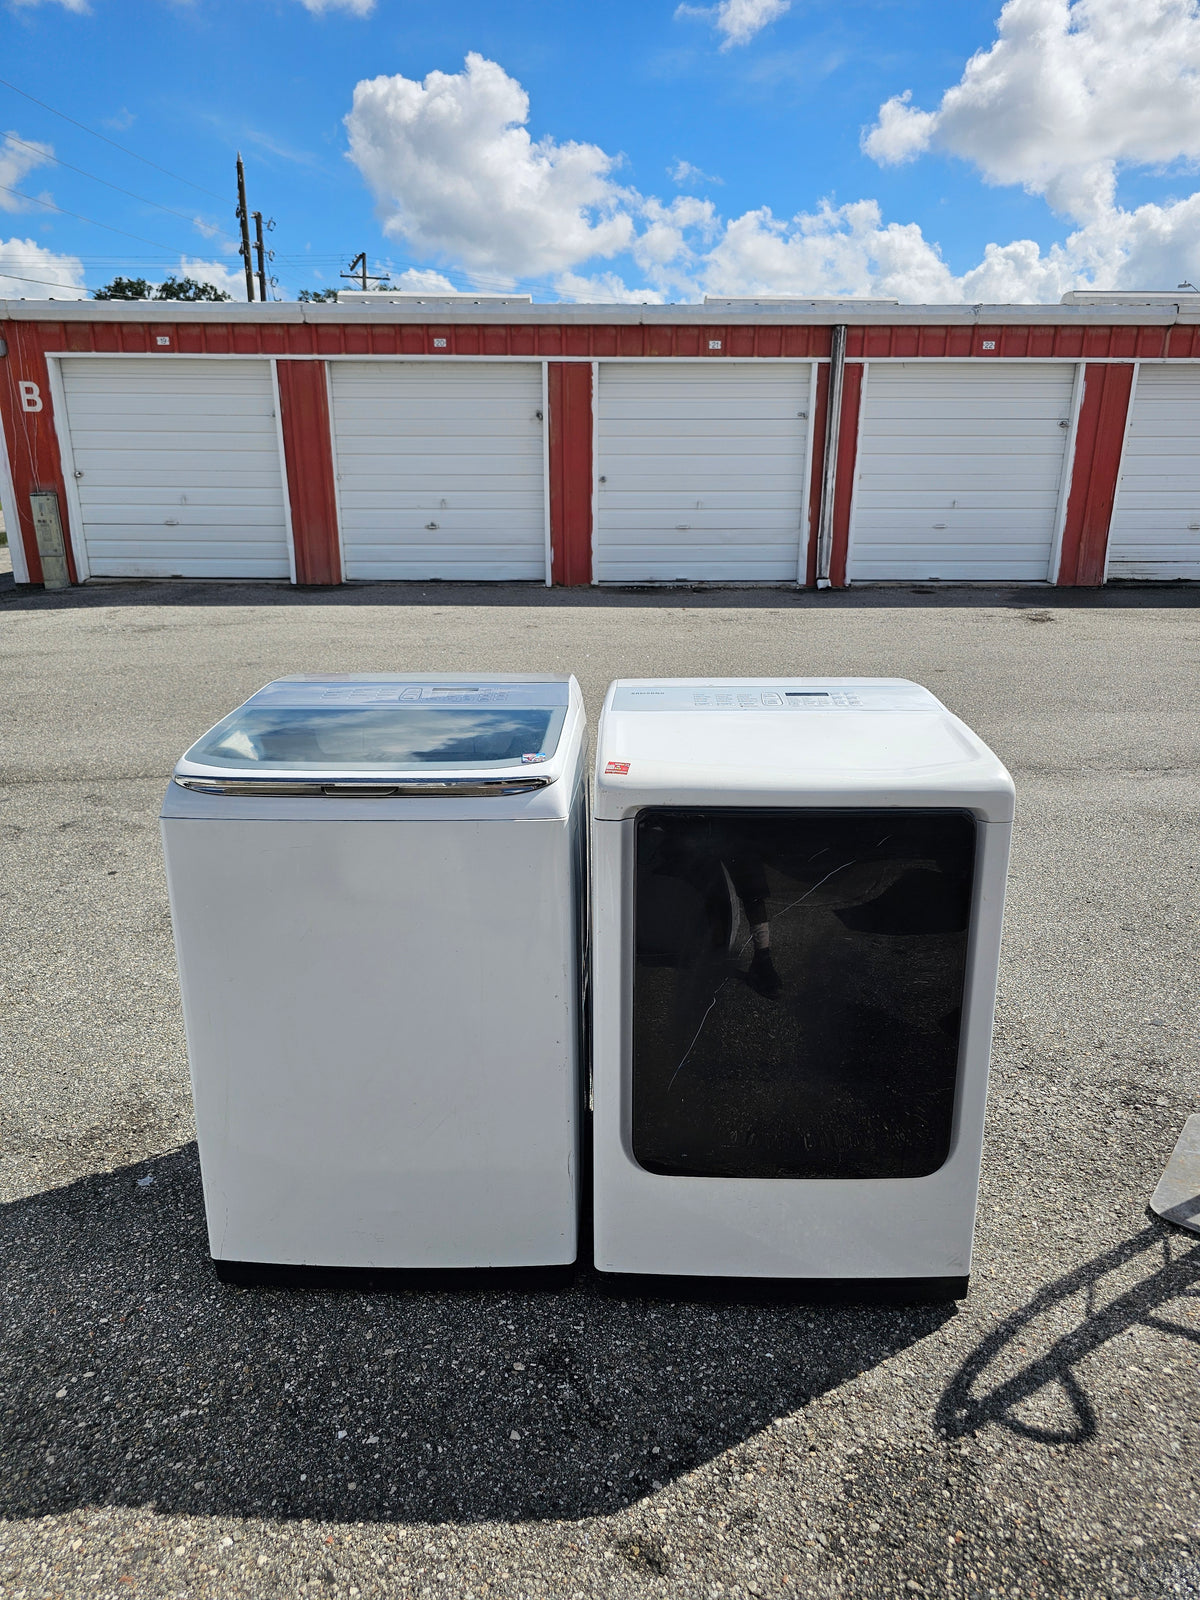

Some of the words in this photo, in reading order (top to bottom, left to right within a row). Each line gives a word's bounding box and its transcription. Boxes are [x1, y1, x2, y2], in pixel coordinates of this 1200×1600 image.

[435, 339, 445, 347] 20
[711, 341, 719, 349] 21
[18, 381, 43, 412] B
